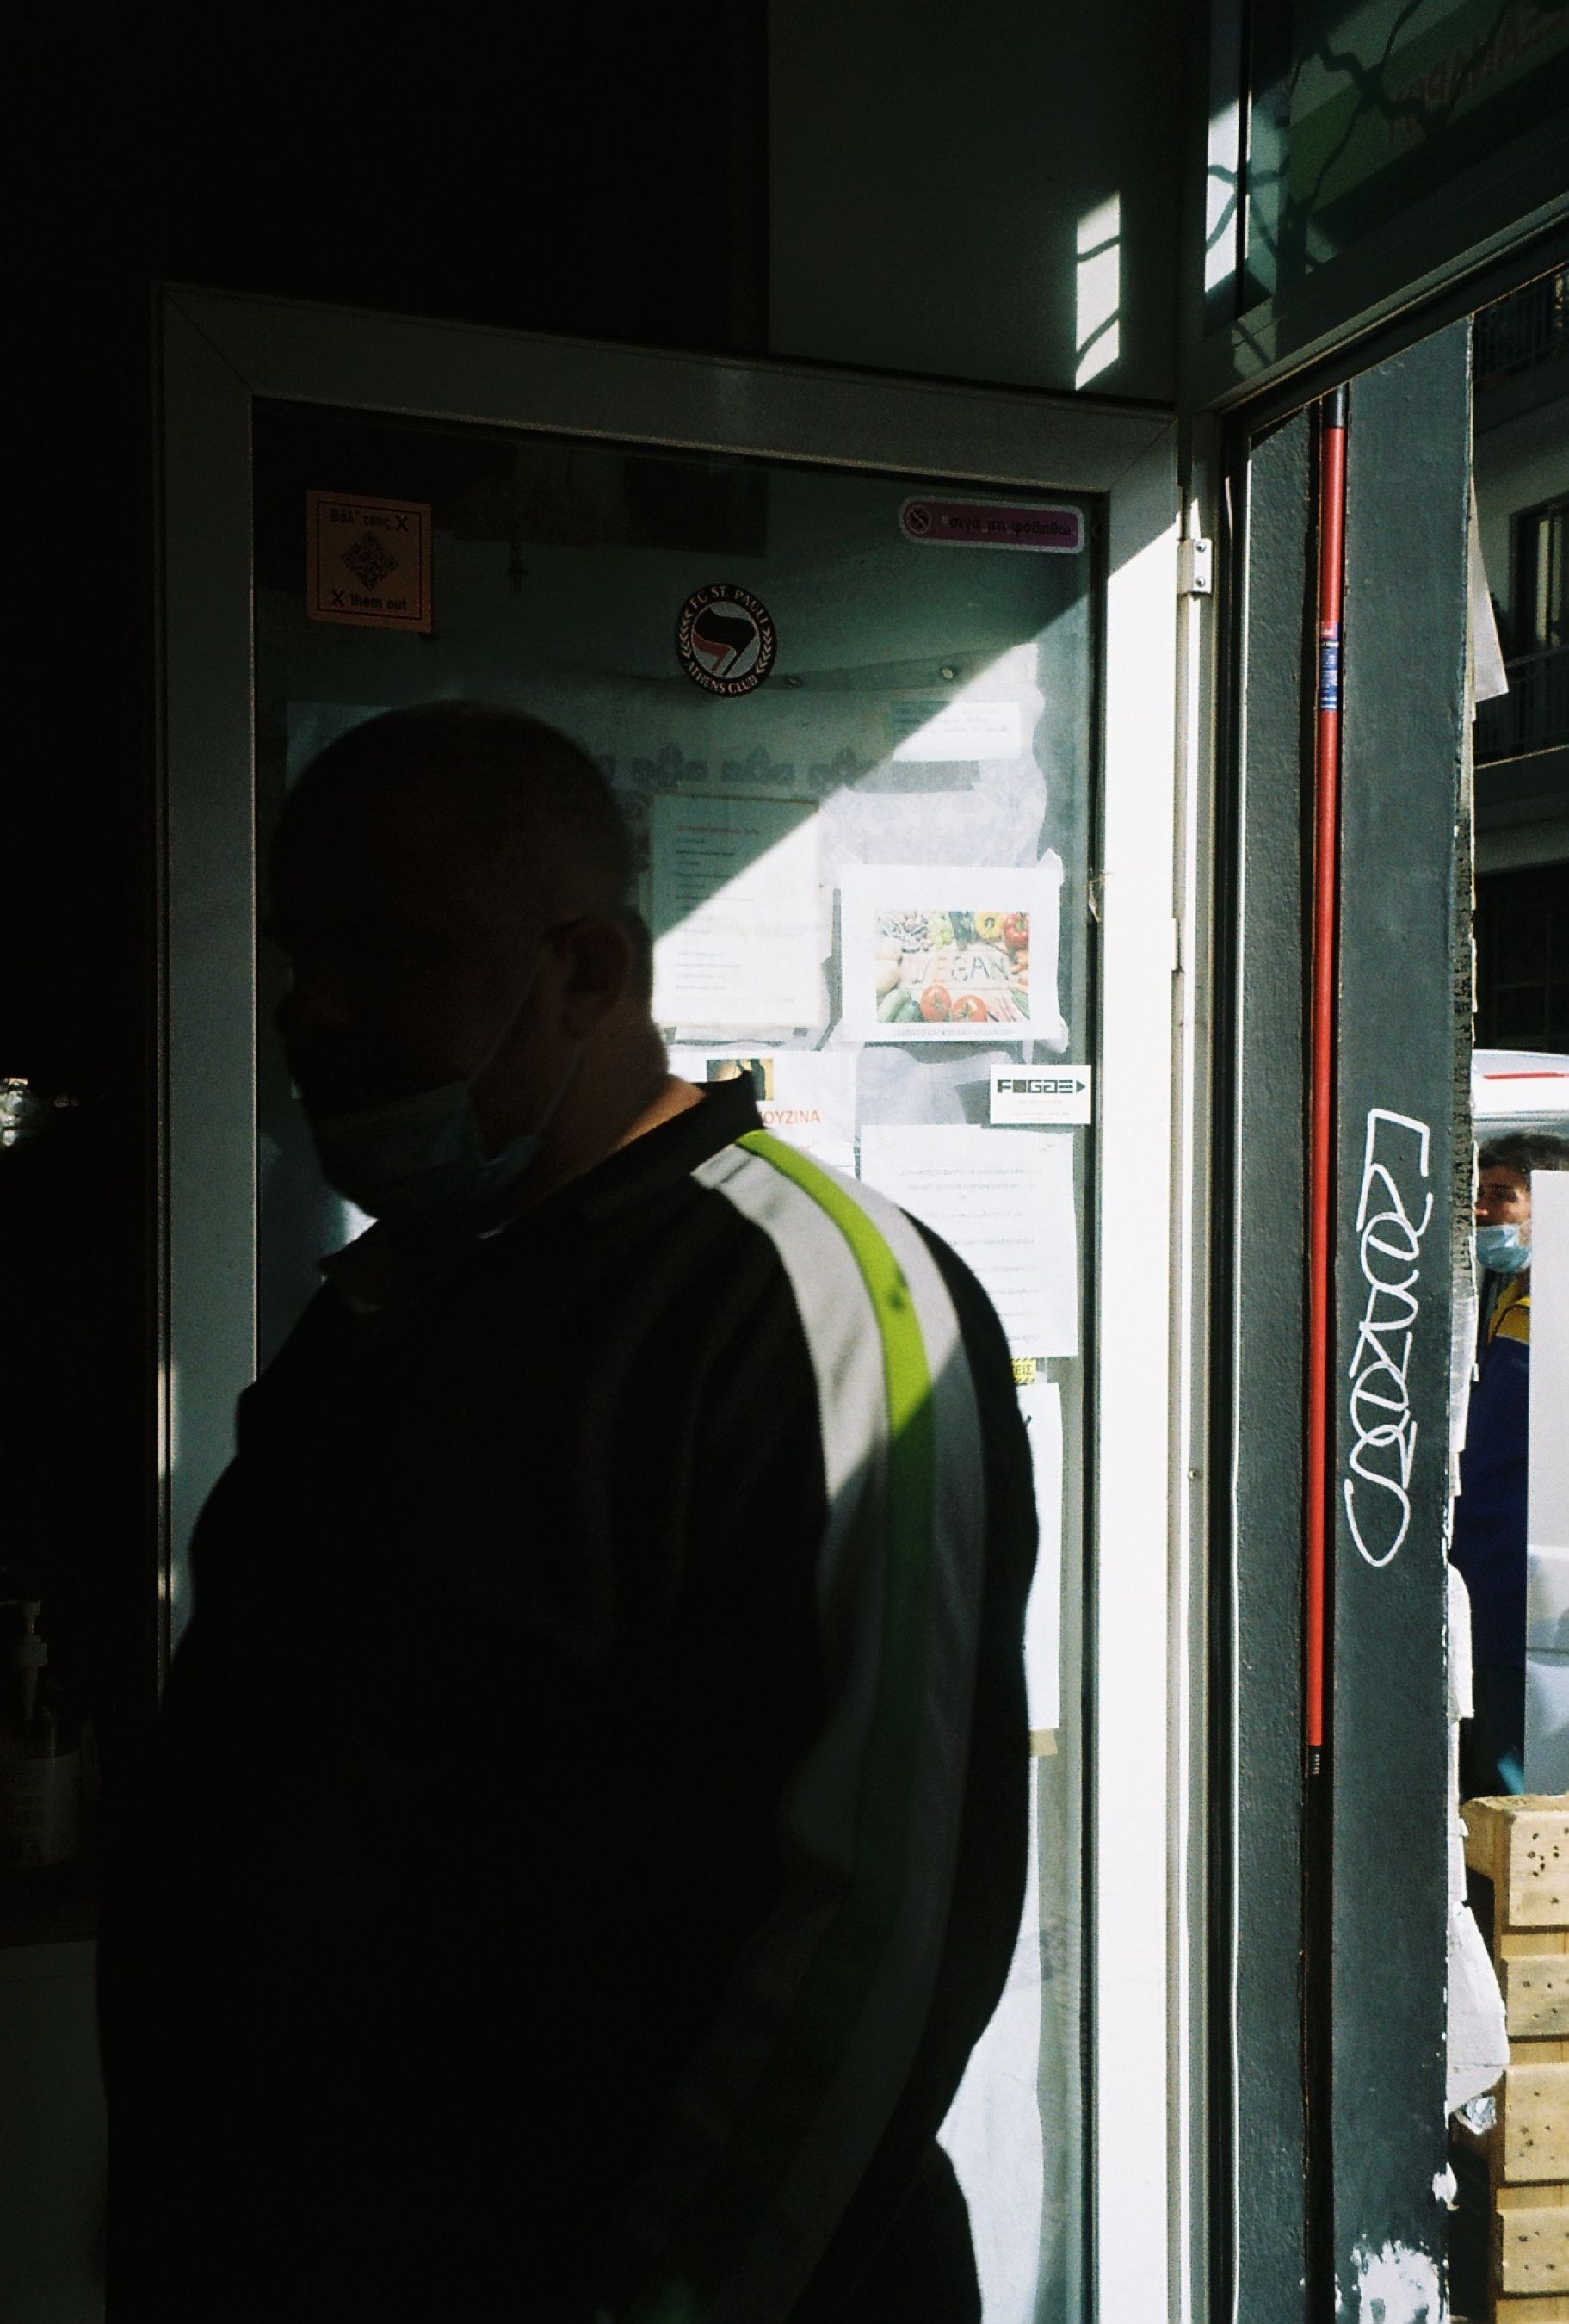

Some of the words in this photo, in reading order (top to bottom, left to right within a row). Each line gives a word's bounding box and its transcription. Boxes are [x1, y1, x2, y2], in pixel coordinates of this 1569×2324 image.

[350, 592, 382, 609] them
[387, 598, 407, 611] out
[910, 955, 1009, 985] VEGAN
[762, 1109, 821, 1124] ΟΥΖΙΝΑ
